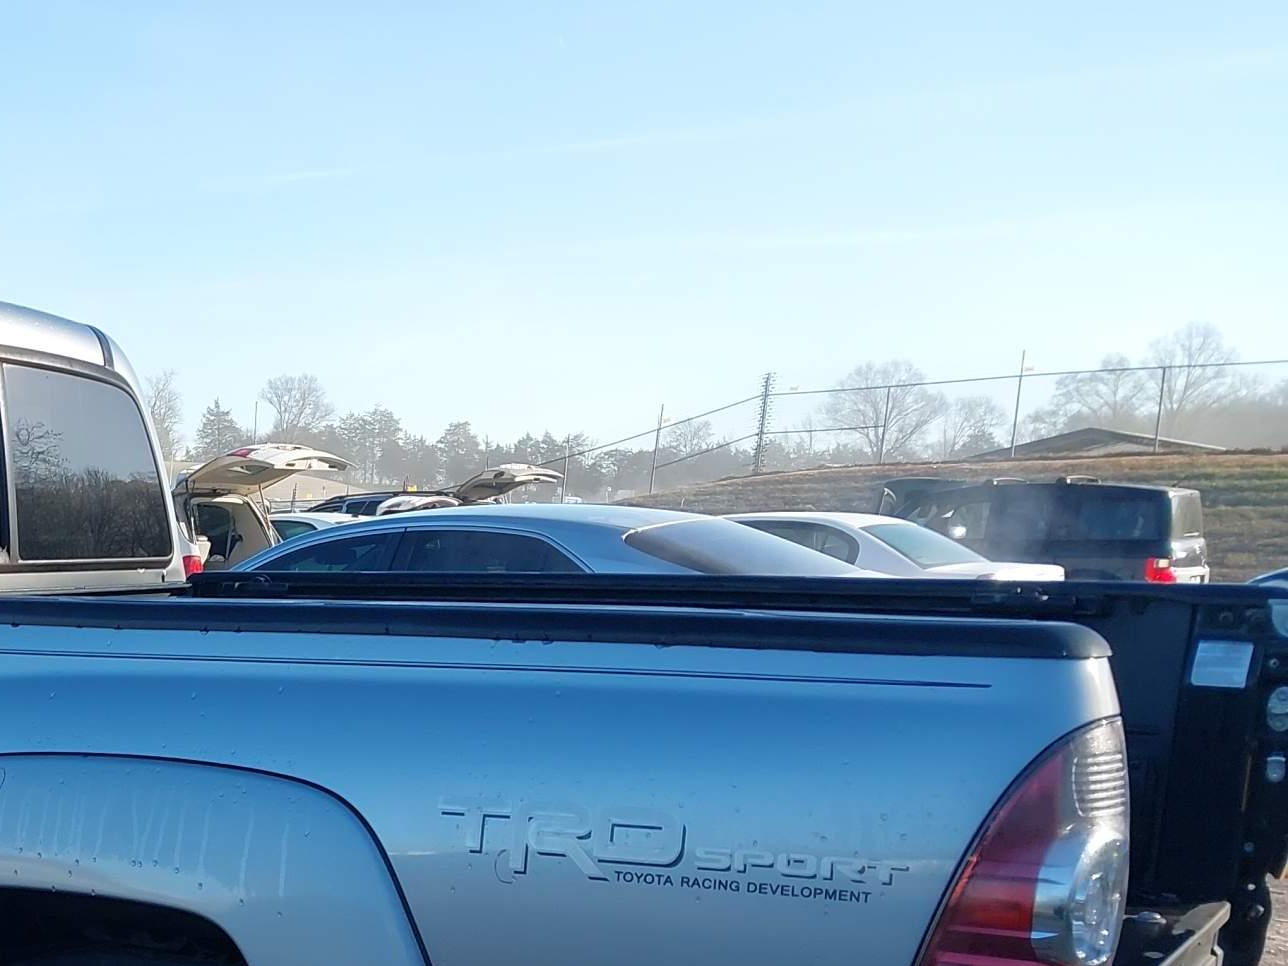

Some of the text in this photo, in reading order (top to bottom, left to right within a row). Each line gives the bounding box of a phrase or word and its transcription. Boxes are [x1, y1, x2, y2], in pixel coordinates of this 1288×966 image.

[440, 799, 911, 886] TRD SPORT
[614, 871, 872, 904] TOYOTA RACING DEVELOPMENT
